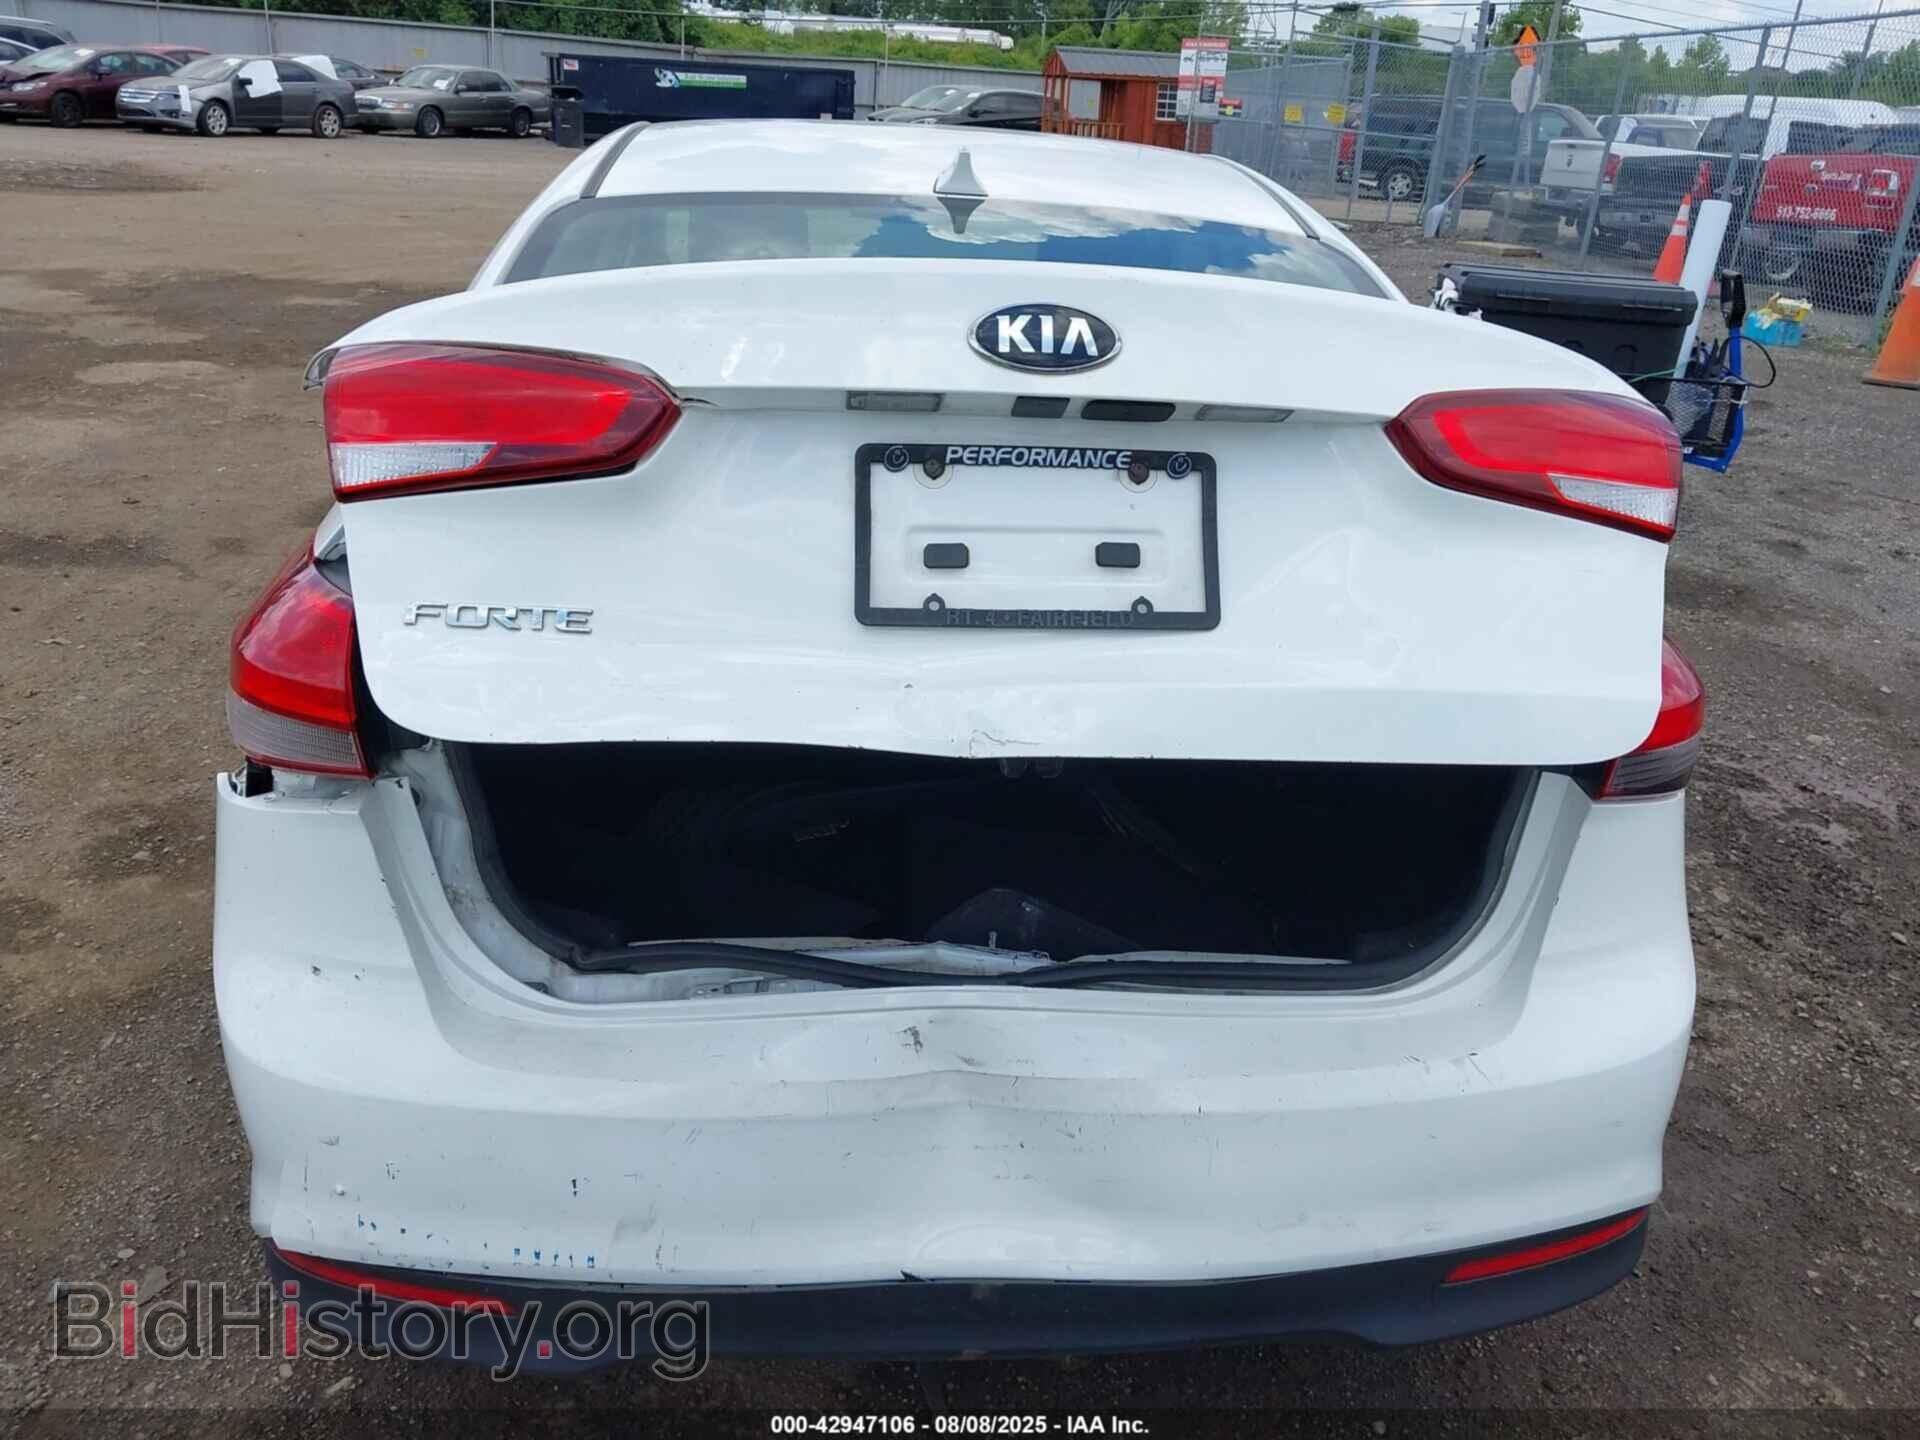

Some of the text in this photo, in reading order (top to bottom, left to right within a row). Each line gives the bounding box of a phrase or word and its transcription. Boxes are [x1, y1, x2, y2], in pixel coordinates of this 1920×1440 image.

[995, 314, 1098, 357] KIA
[945, 446, 1133, 469] PERFORMANCE
[403, 602, 594, 634] FORTE
[1017, 610, 1135, 627] FAIRFIELD
